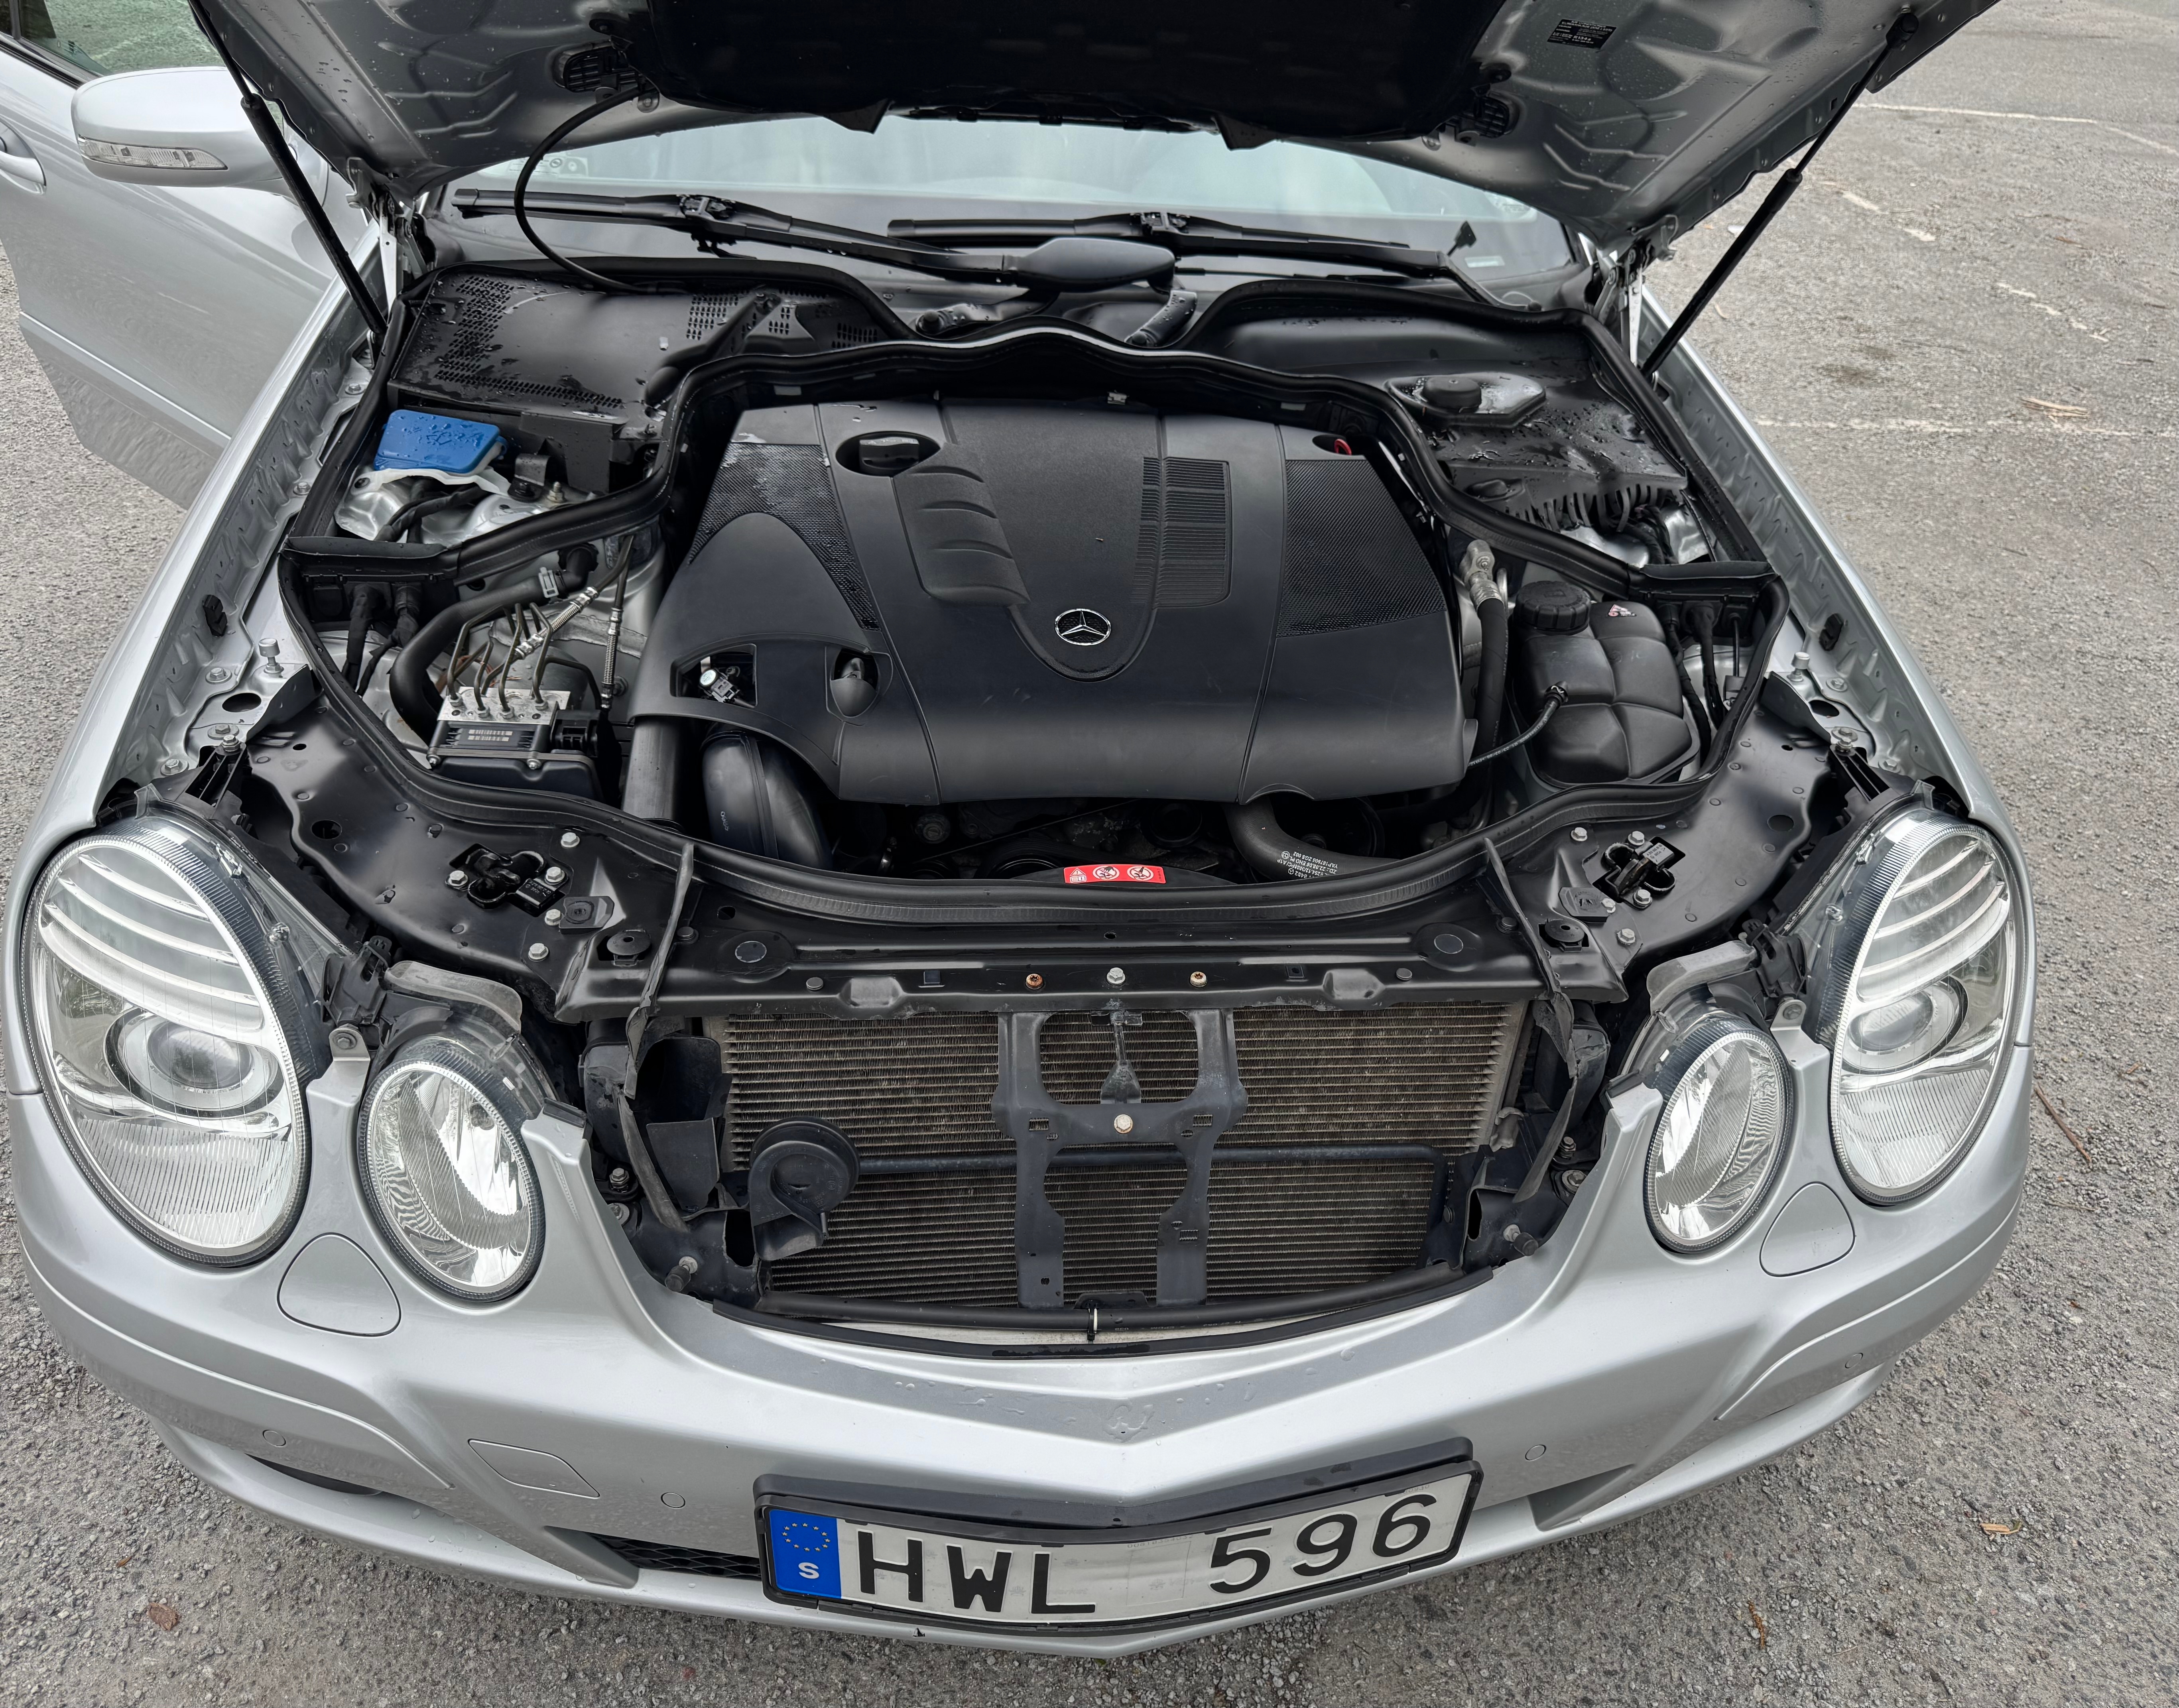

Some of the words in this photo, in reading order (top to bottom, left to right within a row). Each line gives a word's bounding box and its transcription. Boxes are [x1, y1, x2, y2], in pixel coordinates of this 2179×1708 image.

[798, 1562, 819, 1579] S
[857, 1531, 1096, 1615] HWL
[1210, 1494, 1437, 1594] 596
